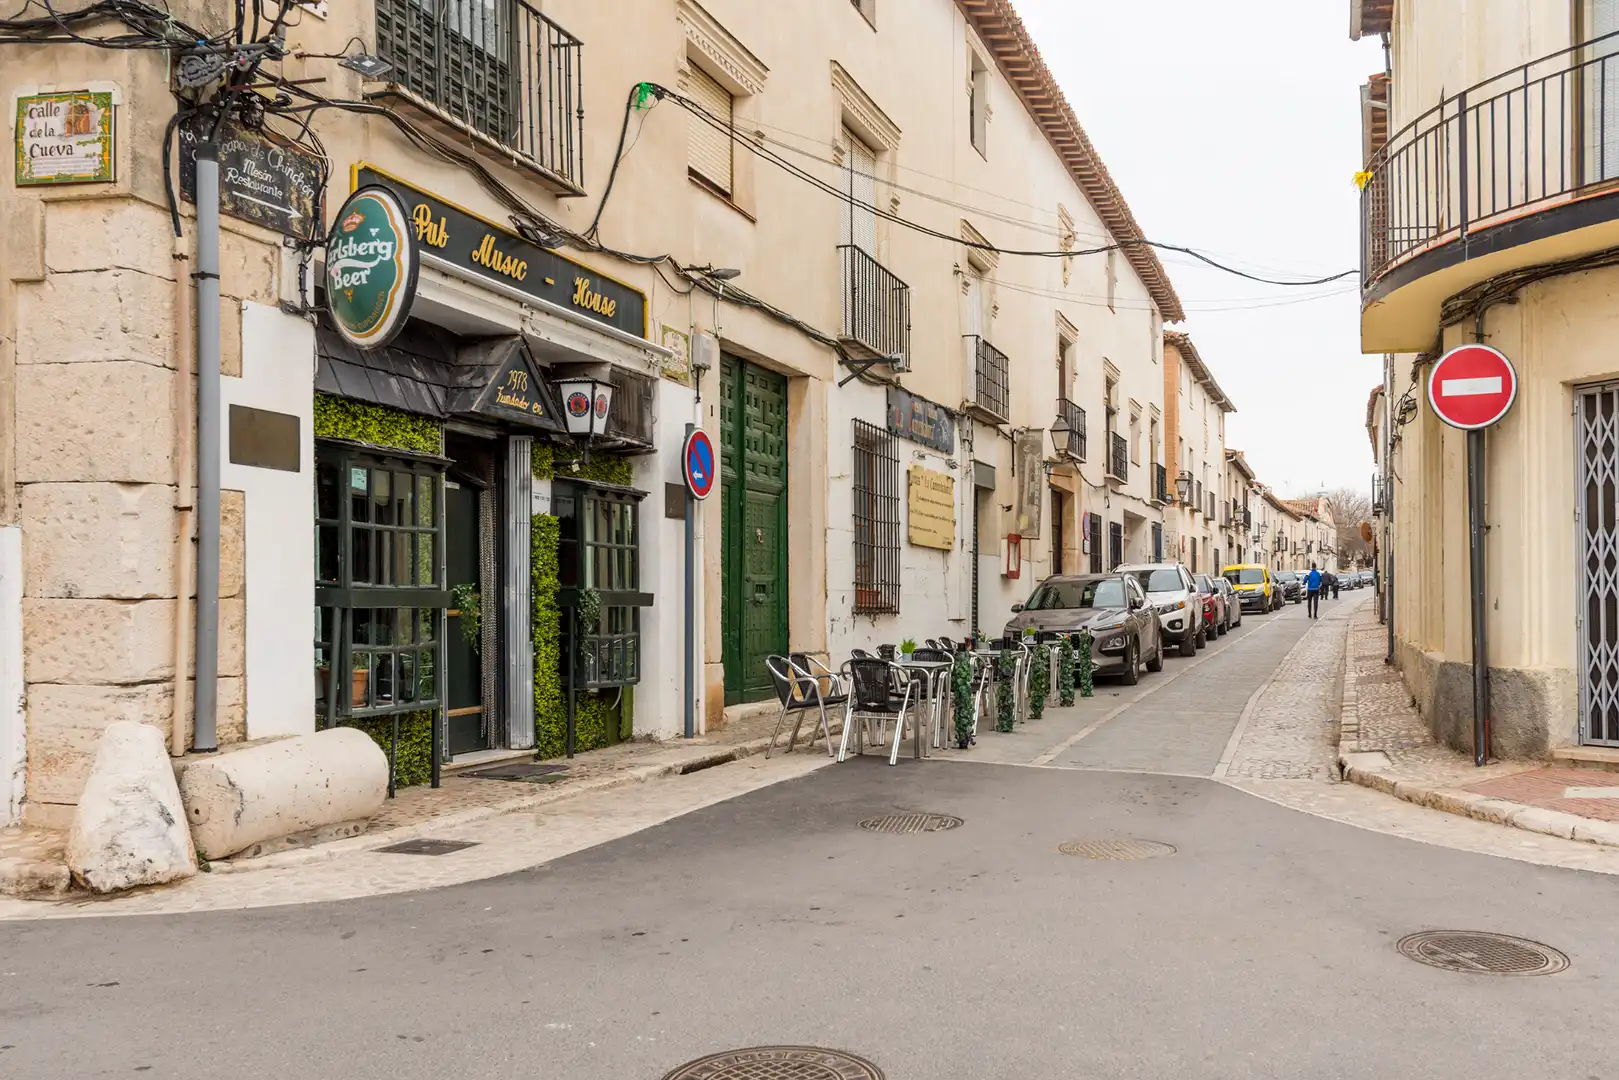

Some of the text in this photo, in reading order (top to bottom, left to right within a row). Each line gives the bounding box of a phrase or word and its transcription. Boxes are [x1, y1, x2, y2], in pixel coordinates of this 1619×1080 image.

[29, 143, 74, 158] Cueva
[243, 158, 272, 183] Mesón
[268, 148, 315, 198] Chinchón
[225, 167, 284, 199] Restaurante
[412, 203, 449, 248] Pub
[472, 234, 527, 281] Music
[573, 276, 616, 317] House
[333, 267, 371, 290] Beer
[507, 369, 529, 391] 1978
[495, 386, 529, 409] Fundado
